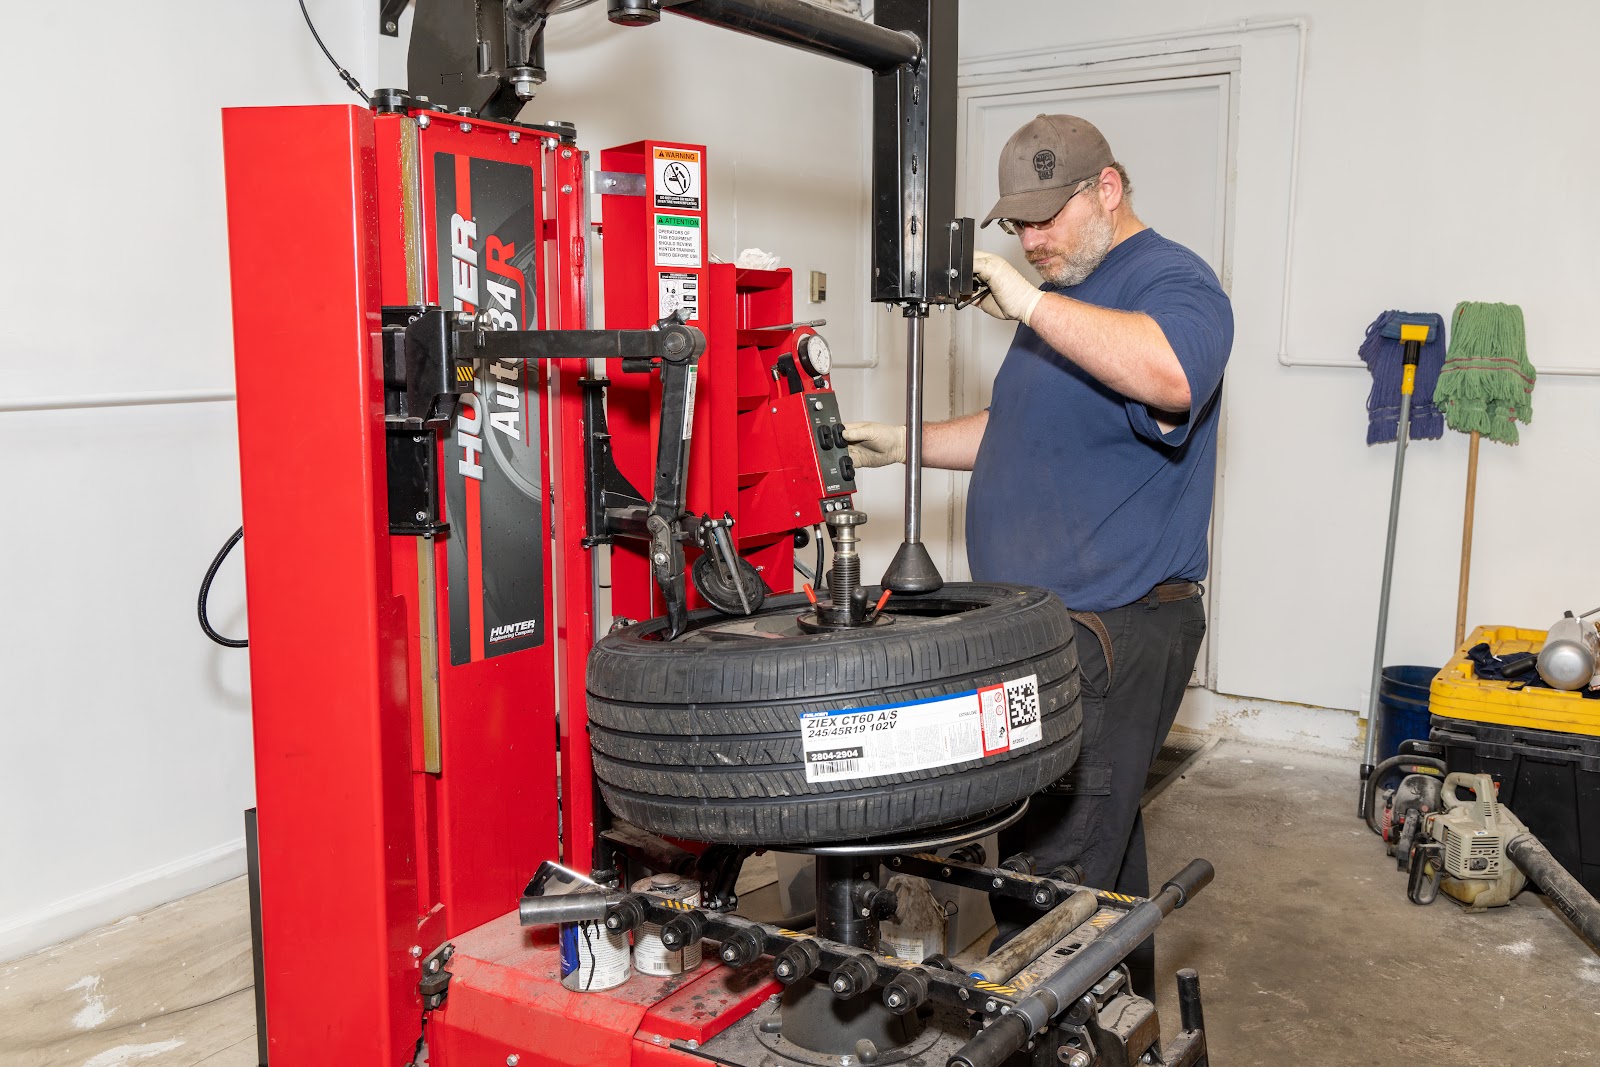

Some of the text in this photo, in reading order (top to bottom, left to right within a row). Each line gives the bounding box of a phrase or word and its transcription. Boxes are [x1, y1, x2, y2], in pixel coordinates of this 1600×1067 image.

[665, 151, 695, 161] WARNING
[665, 218, 699, 226] ATTENTION
[451, 213, 484, 480] HUER
[485, 234, 525, 441] Aut34R
[489, 628, 534, 642] Engineering Company
[490, 619, 536, 637] HUNTER
[807, 710, 898, 729] ZIEX CT60 A/S
[808, 720, 897, 738] 245/45R19 102V
[811, 749, 859, 761] 2804-2904
